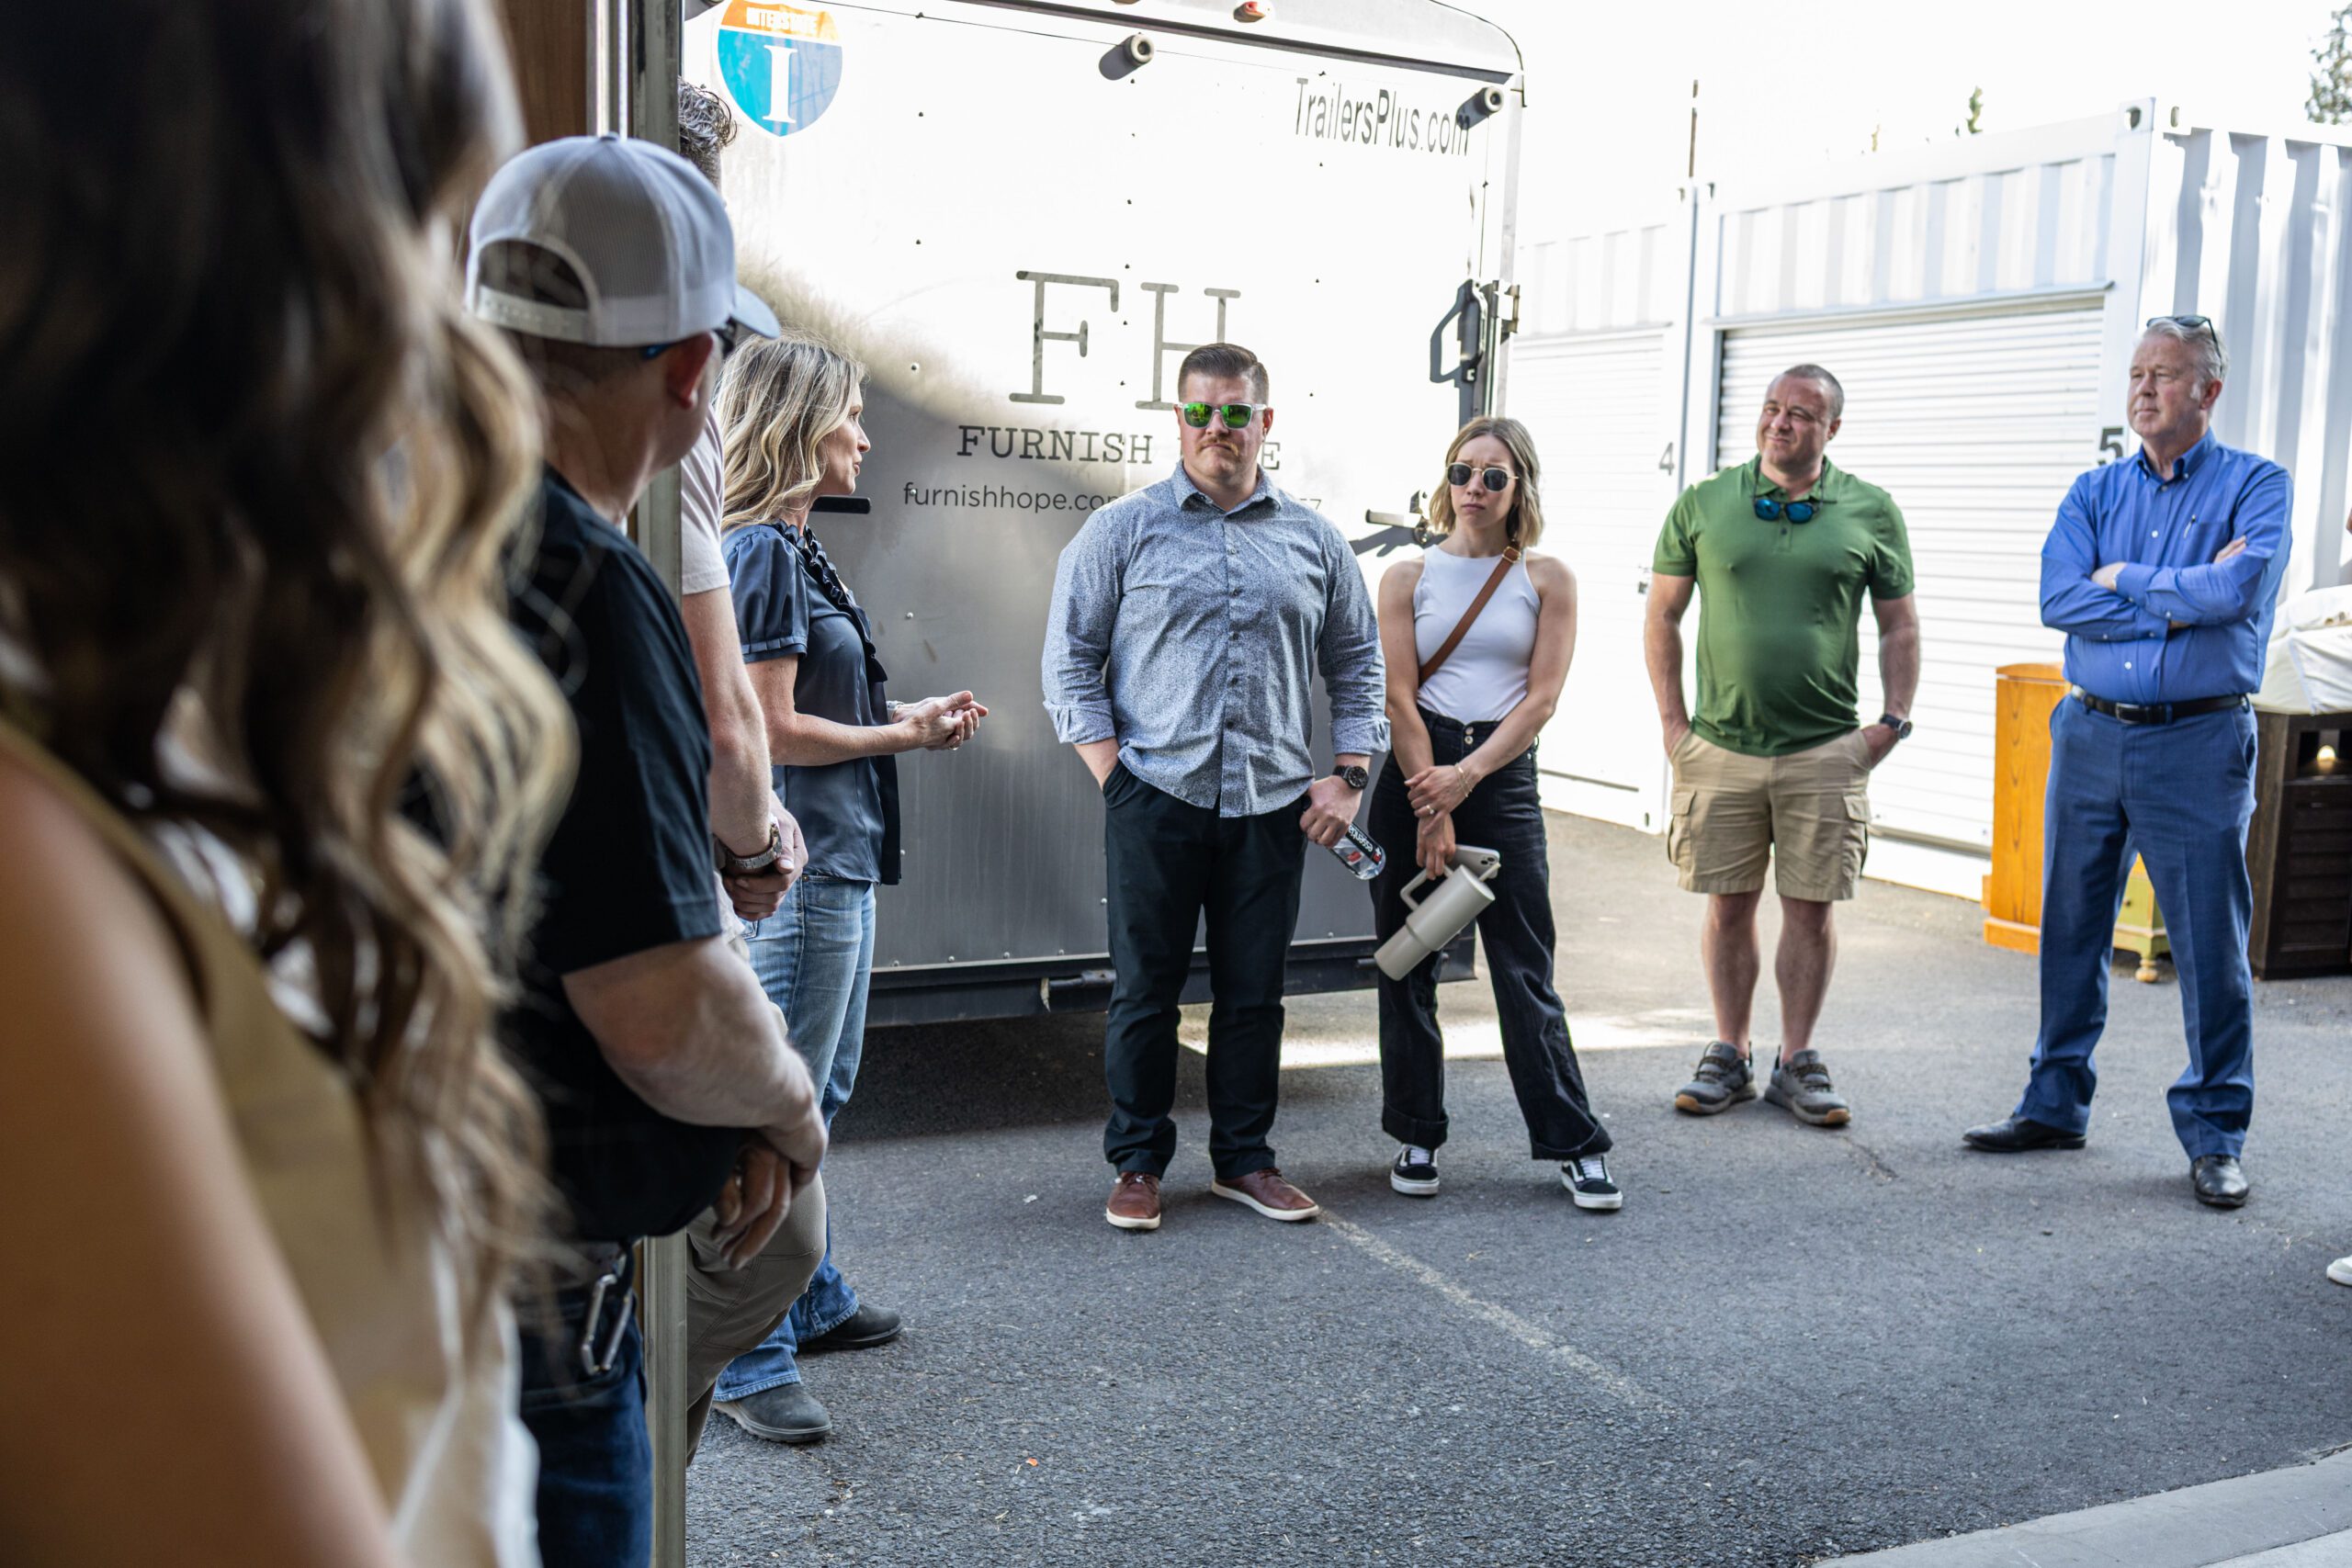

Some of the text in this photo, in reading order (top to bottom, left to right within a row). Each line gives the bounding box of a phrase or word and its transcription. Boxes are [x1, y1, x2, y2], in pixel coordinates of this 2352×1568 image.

[1295, 76, 1470, 157] TrailersPlus.com
[1009, 270, 1242, 411] FH
[956, 424, 1153, 465] FURNISH
[1658, 441, 1675, 476] 4
[2098, 426, 2124, 466] 5
